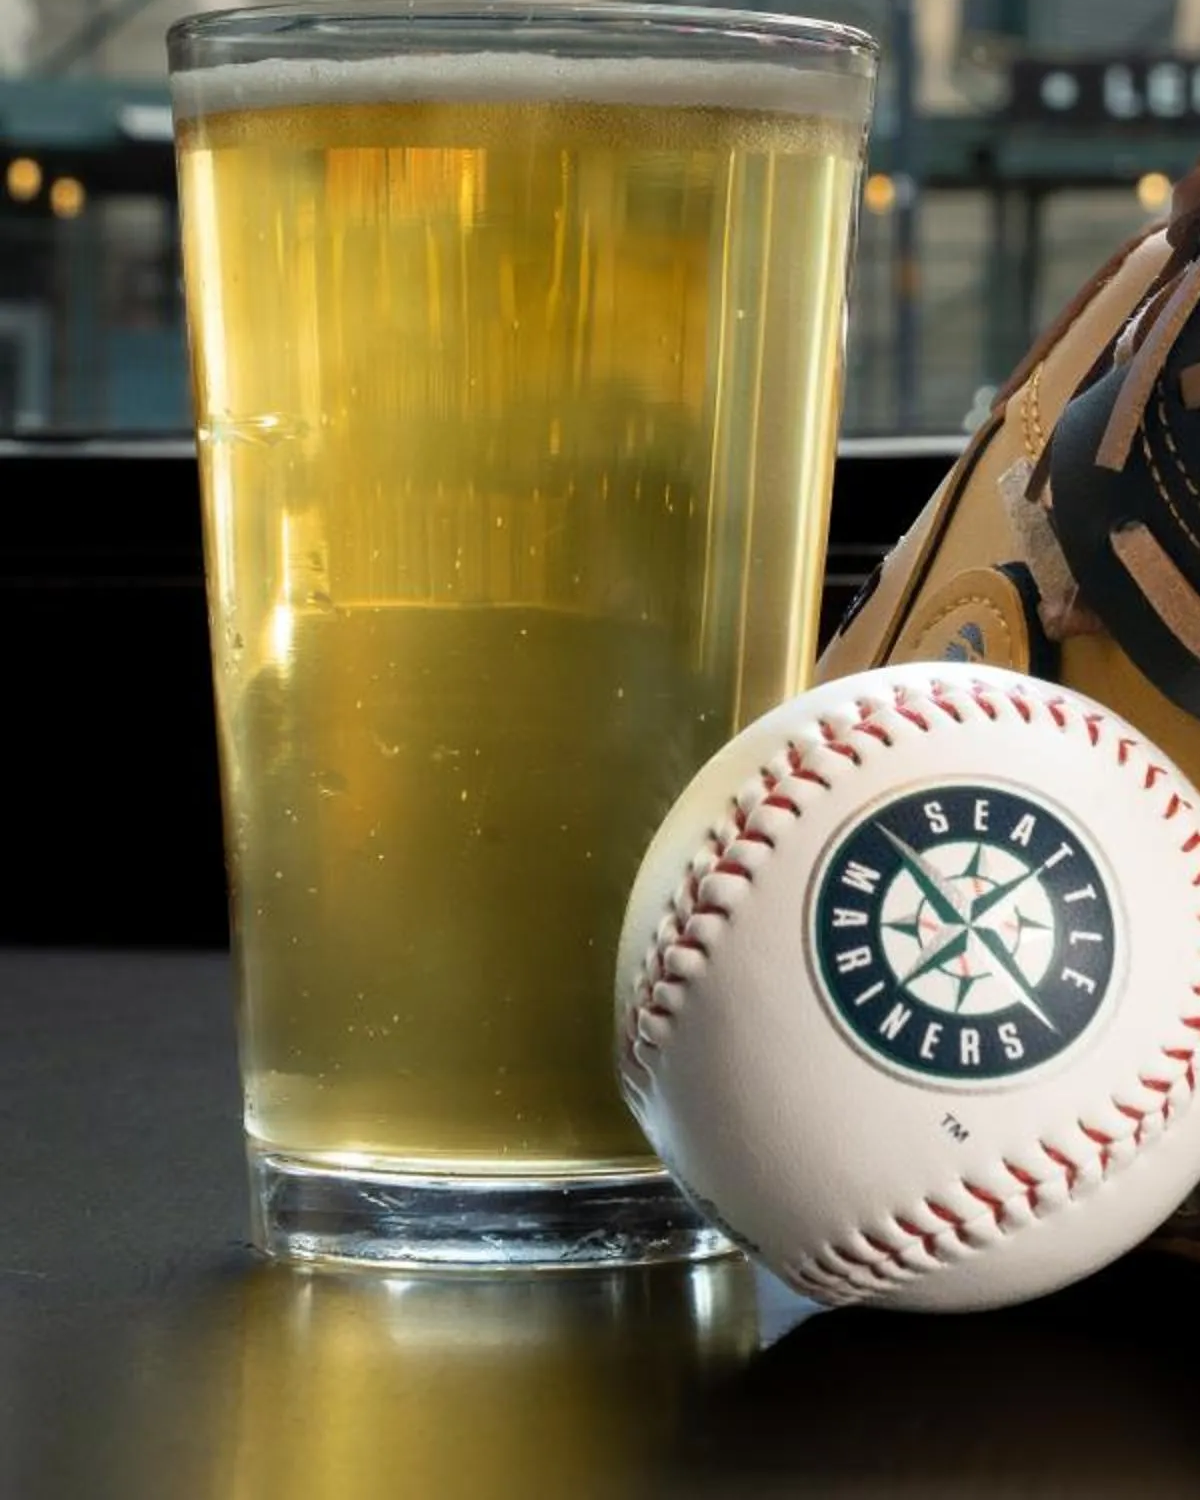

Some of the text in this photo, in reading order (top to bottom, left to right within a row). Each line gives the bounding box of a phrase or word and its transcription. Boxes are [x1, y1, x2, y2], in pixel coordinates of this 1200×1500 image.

[832, 860, 1026, 1066] MARINERS
[923, 799, 1104, 996] SEATTLE
[939, 1112, 971, 1144] TM
